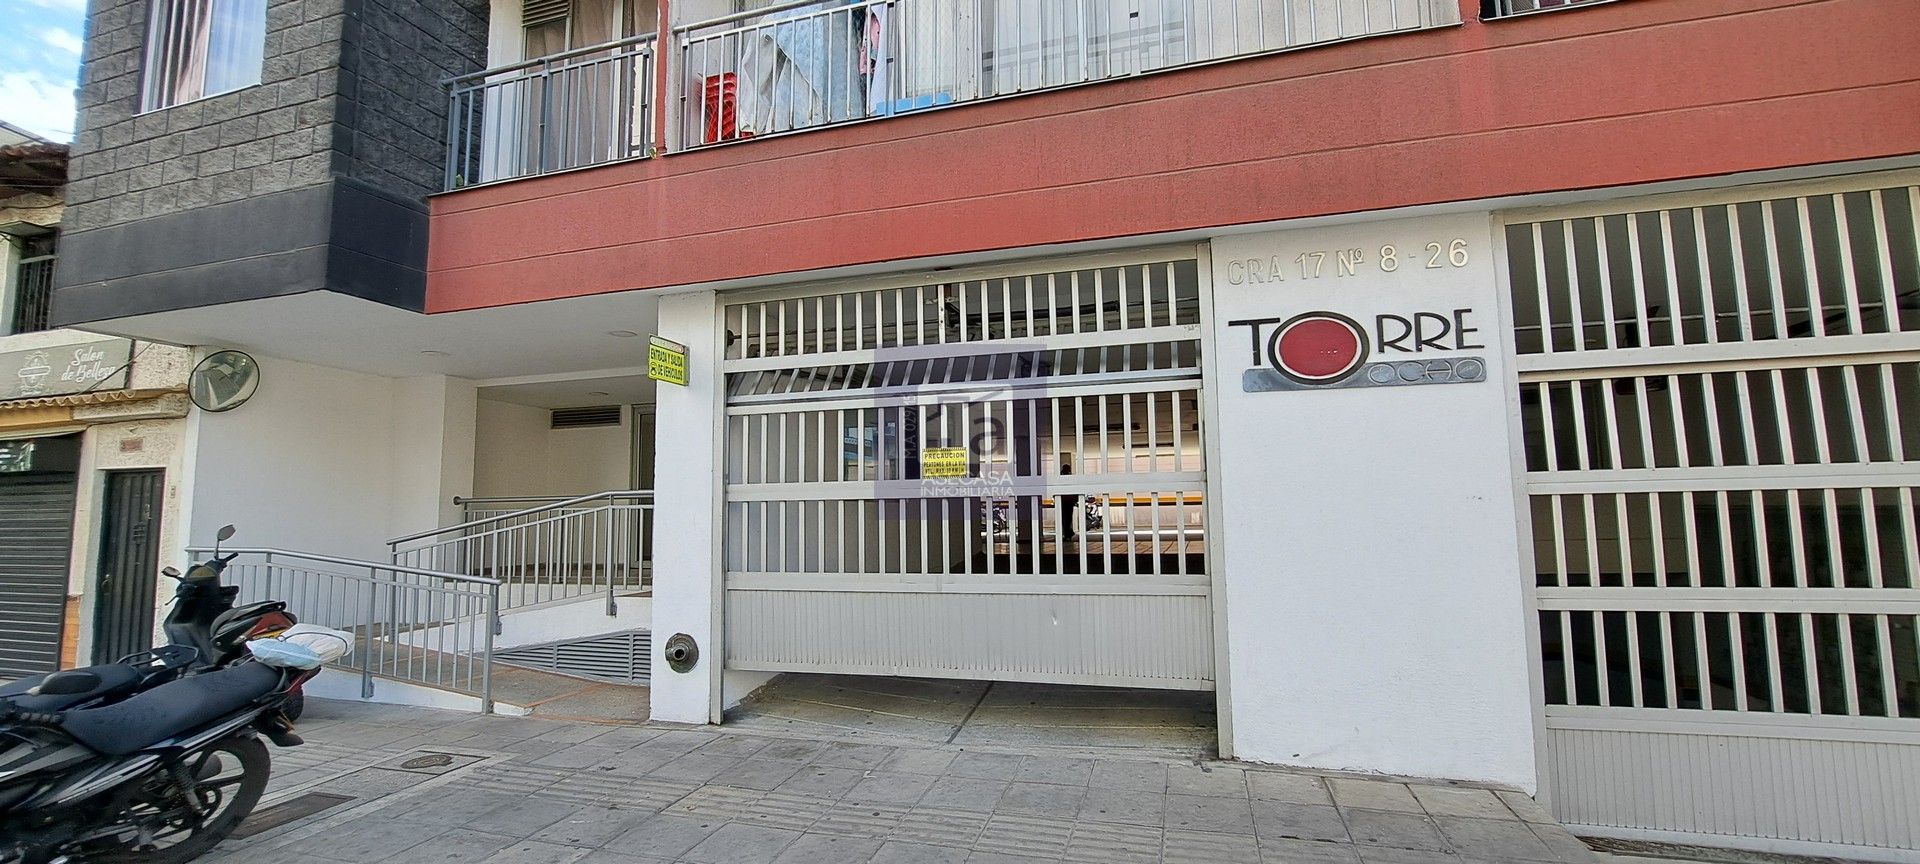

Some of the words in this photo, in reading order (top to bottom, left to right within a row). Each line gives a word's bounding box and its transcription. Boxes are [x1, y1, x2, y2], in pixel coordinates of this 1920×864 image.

[1228, 255, 1284, 285] CRA
[1295, 252, 1328, 280] 17
[1379, 244, 1399, 272] 8
[1425, 238, 1468, 269] 26
[1228, 307, 1485, 385] TORRE
[61, 365, 74, 381] de
[75, 361, 116, 382] Belleza
[1368, 357, 1483, 385] OCHO
[924, 452, 965, 460] PRECAUCION
